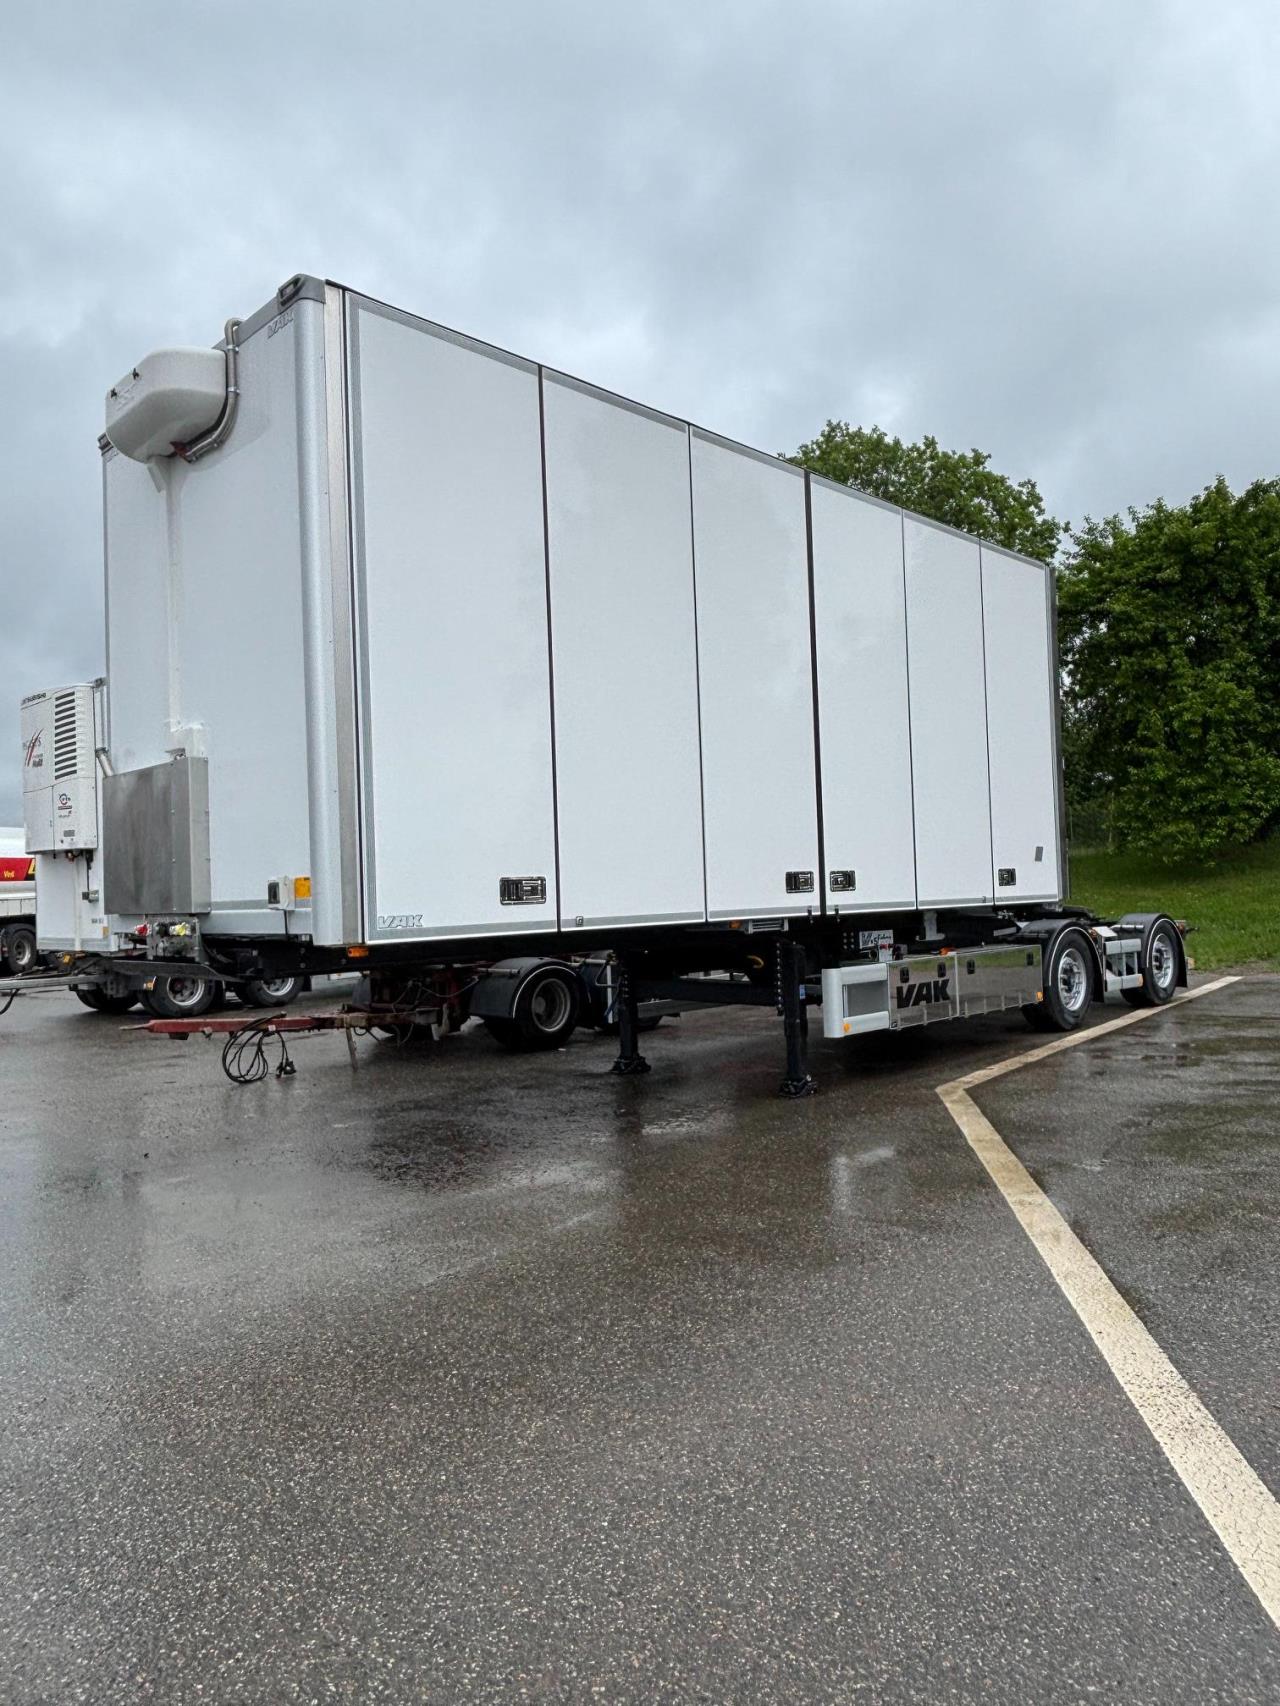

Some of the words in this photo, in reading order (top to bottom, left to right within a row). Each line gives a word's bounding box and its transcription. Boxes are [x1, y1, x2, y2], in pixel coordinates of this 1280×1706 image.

[267, 310, 294, 339] VAK
[377, 914, 424, 929] VAK
[896, 978, 951, 1009] VAK
